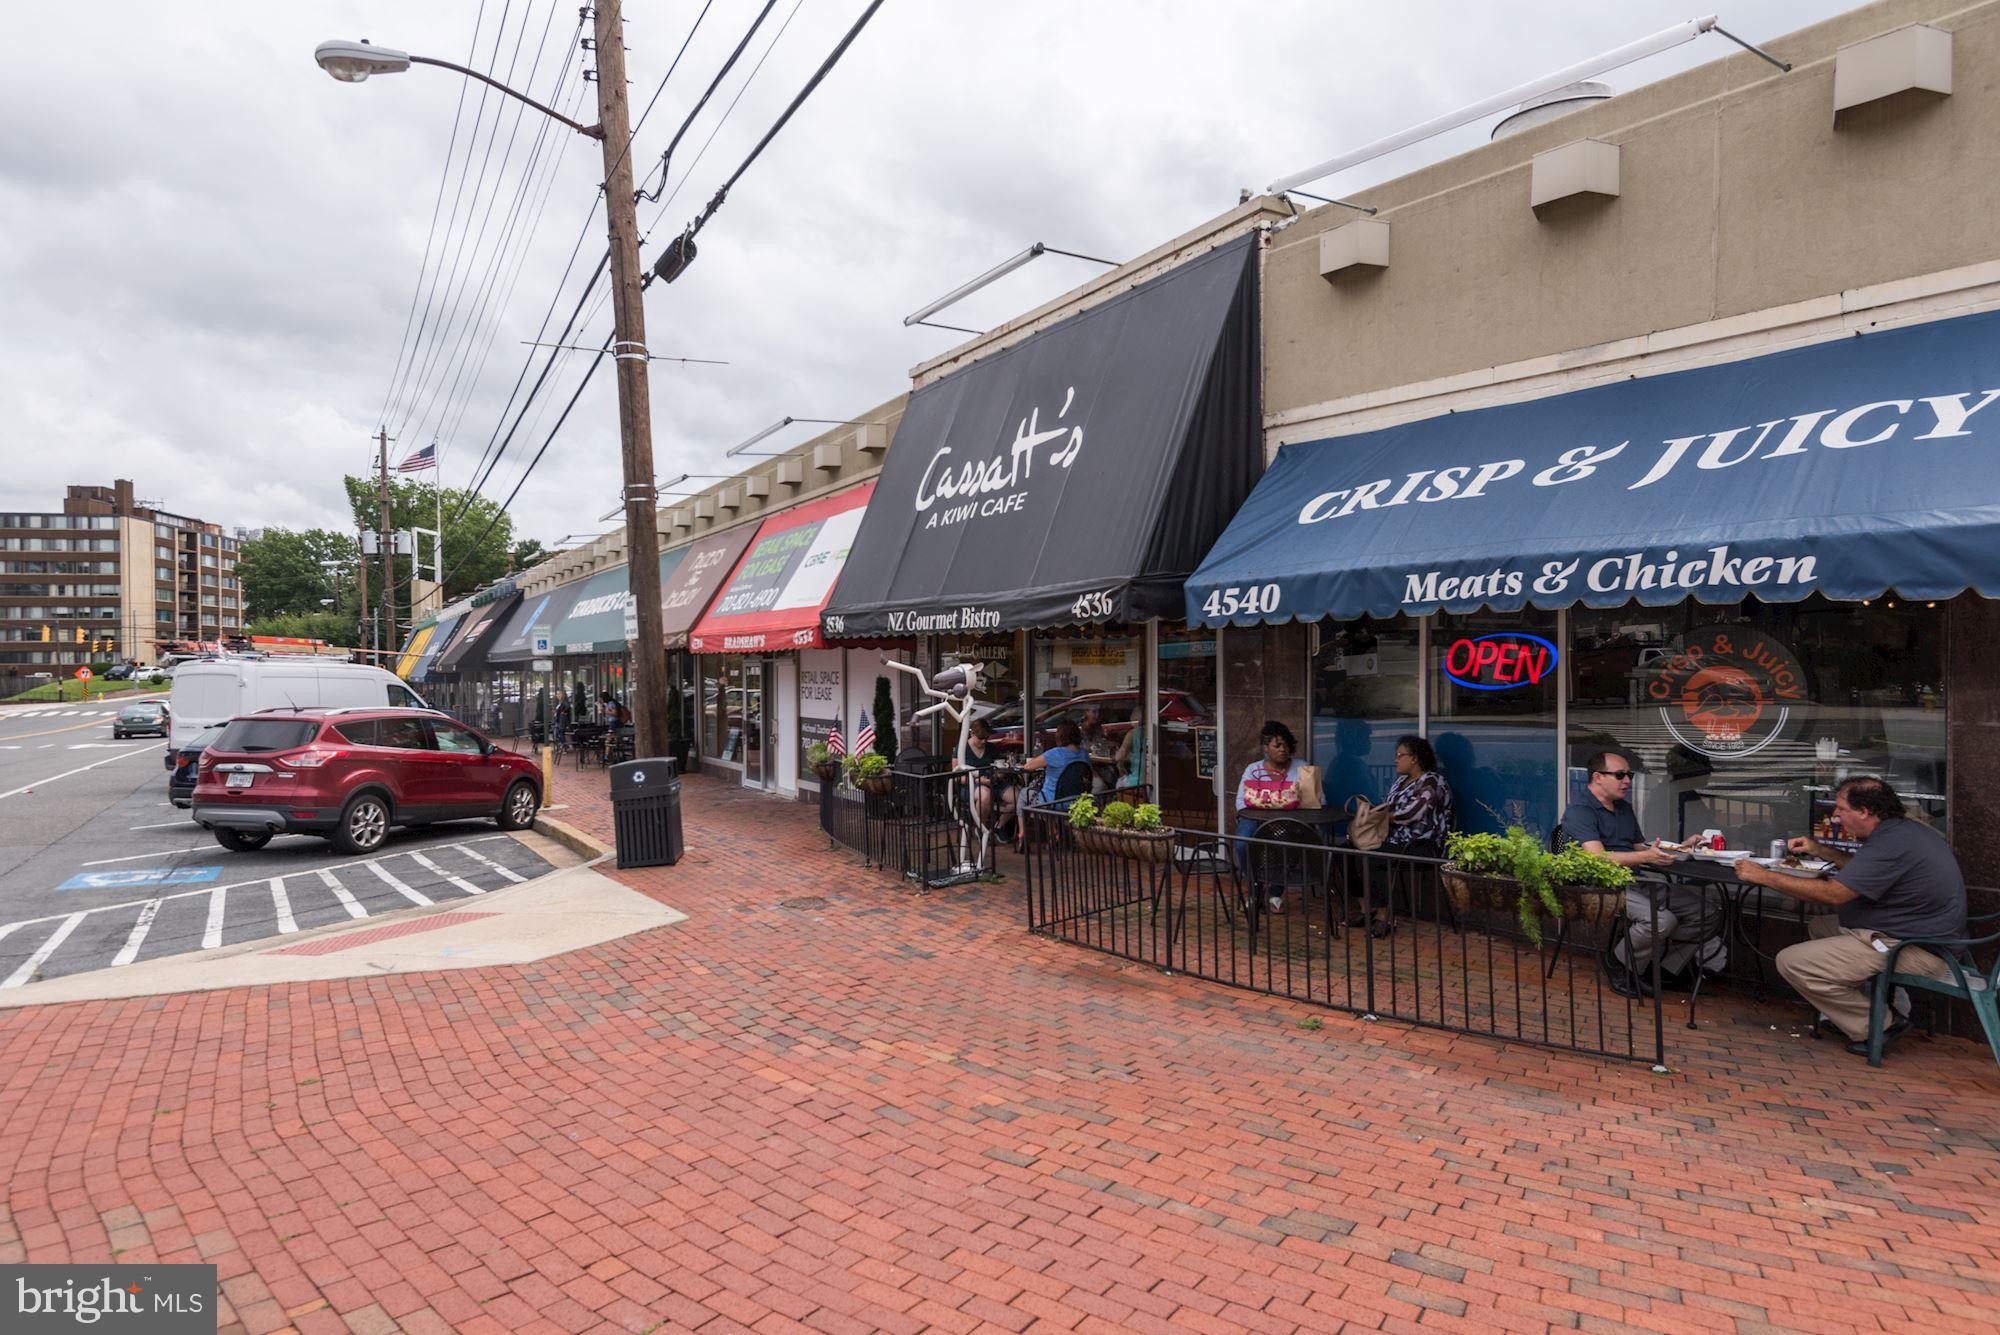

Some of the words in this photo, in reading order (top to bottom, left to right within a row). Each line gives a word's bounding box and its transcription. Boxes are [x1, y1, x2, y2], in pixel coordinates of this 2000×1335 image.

[1297, 459, 1526, 525] CRISP
[1532, 440, 1630, 487] &
[1627, 388, 2000, 490] JUICY
[925, 512, 938, 530] A
[940, 501, 979, 527] KIWI
[980, 491, 1029, 518] CAFE
[1401, 568, 1523, 604] Meats
[1532, 557, 1580, 596] &
[1586, 545, 1818, 593] Chicken
[887, 612, 904, 632] NZ
[906, 610, 957, 632] Gourmet
[960, 606, 1001, 629] Bistro
[1071, 589, 1113, 619] 4536
[1202, 583, 1281, 618] 4540
[801, 670, 818, 685] RETAIL
[820, 671, 840, 686] SPACE
[1446, 638, 1548, 685] OPEN
[1649, 645, 1704, 699] Crisp
[1713, 634, 1734, 655] &
[1743, 641, 1809, 699] Juicy
[801, 686, 813, 700] FOR
[815, 687, 832, 701] LEASE
